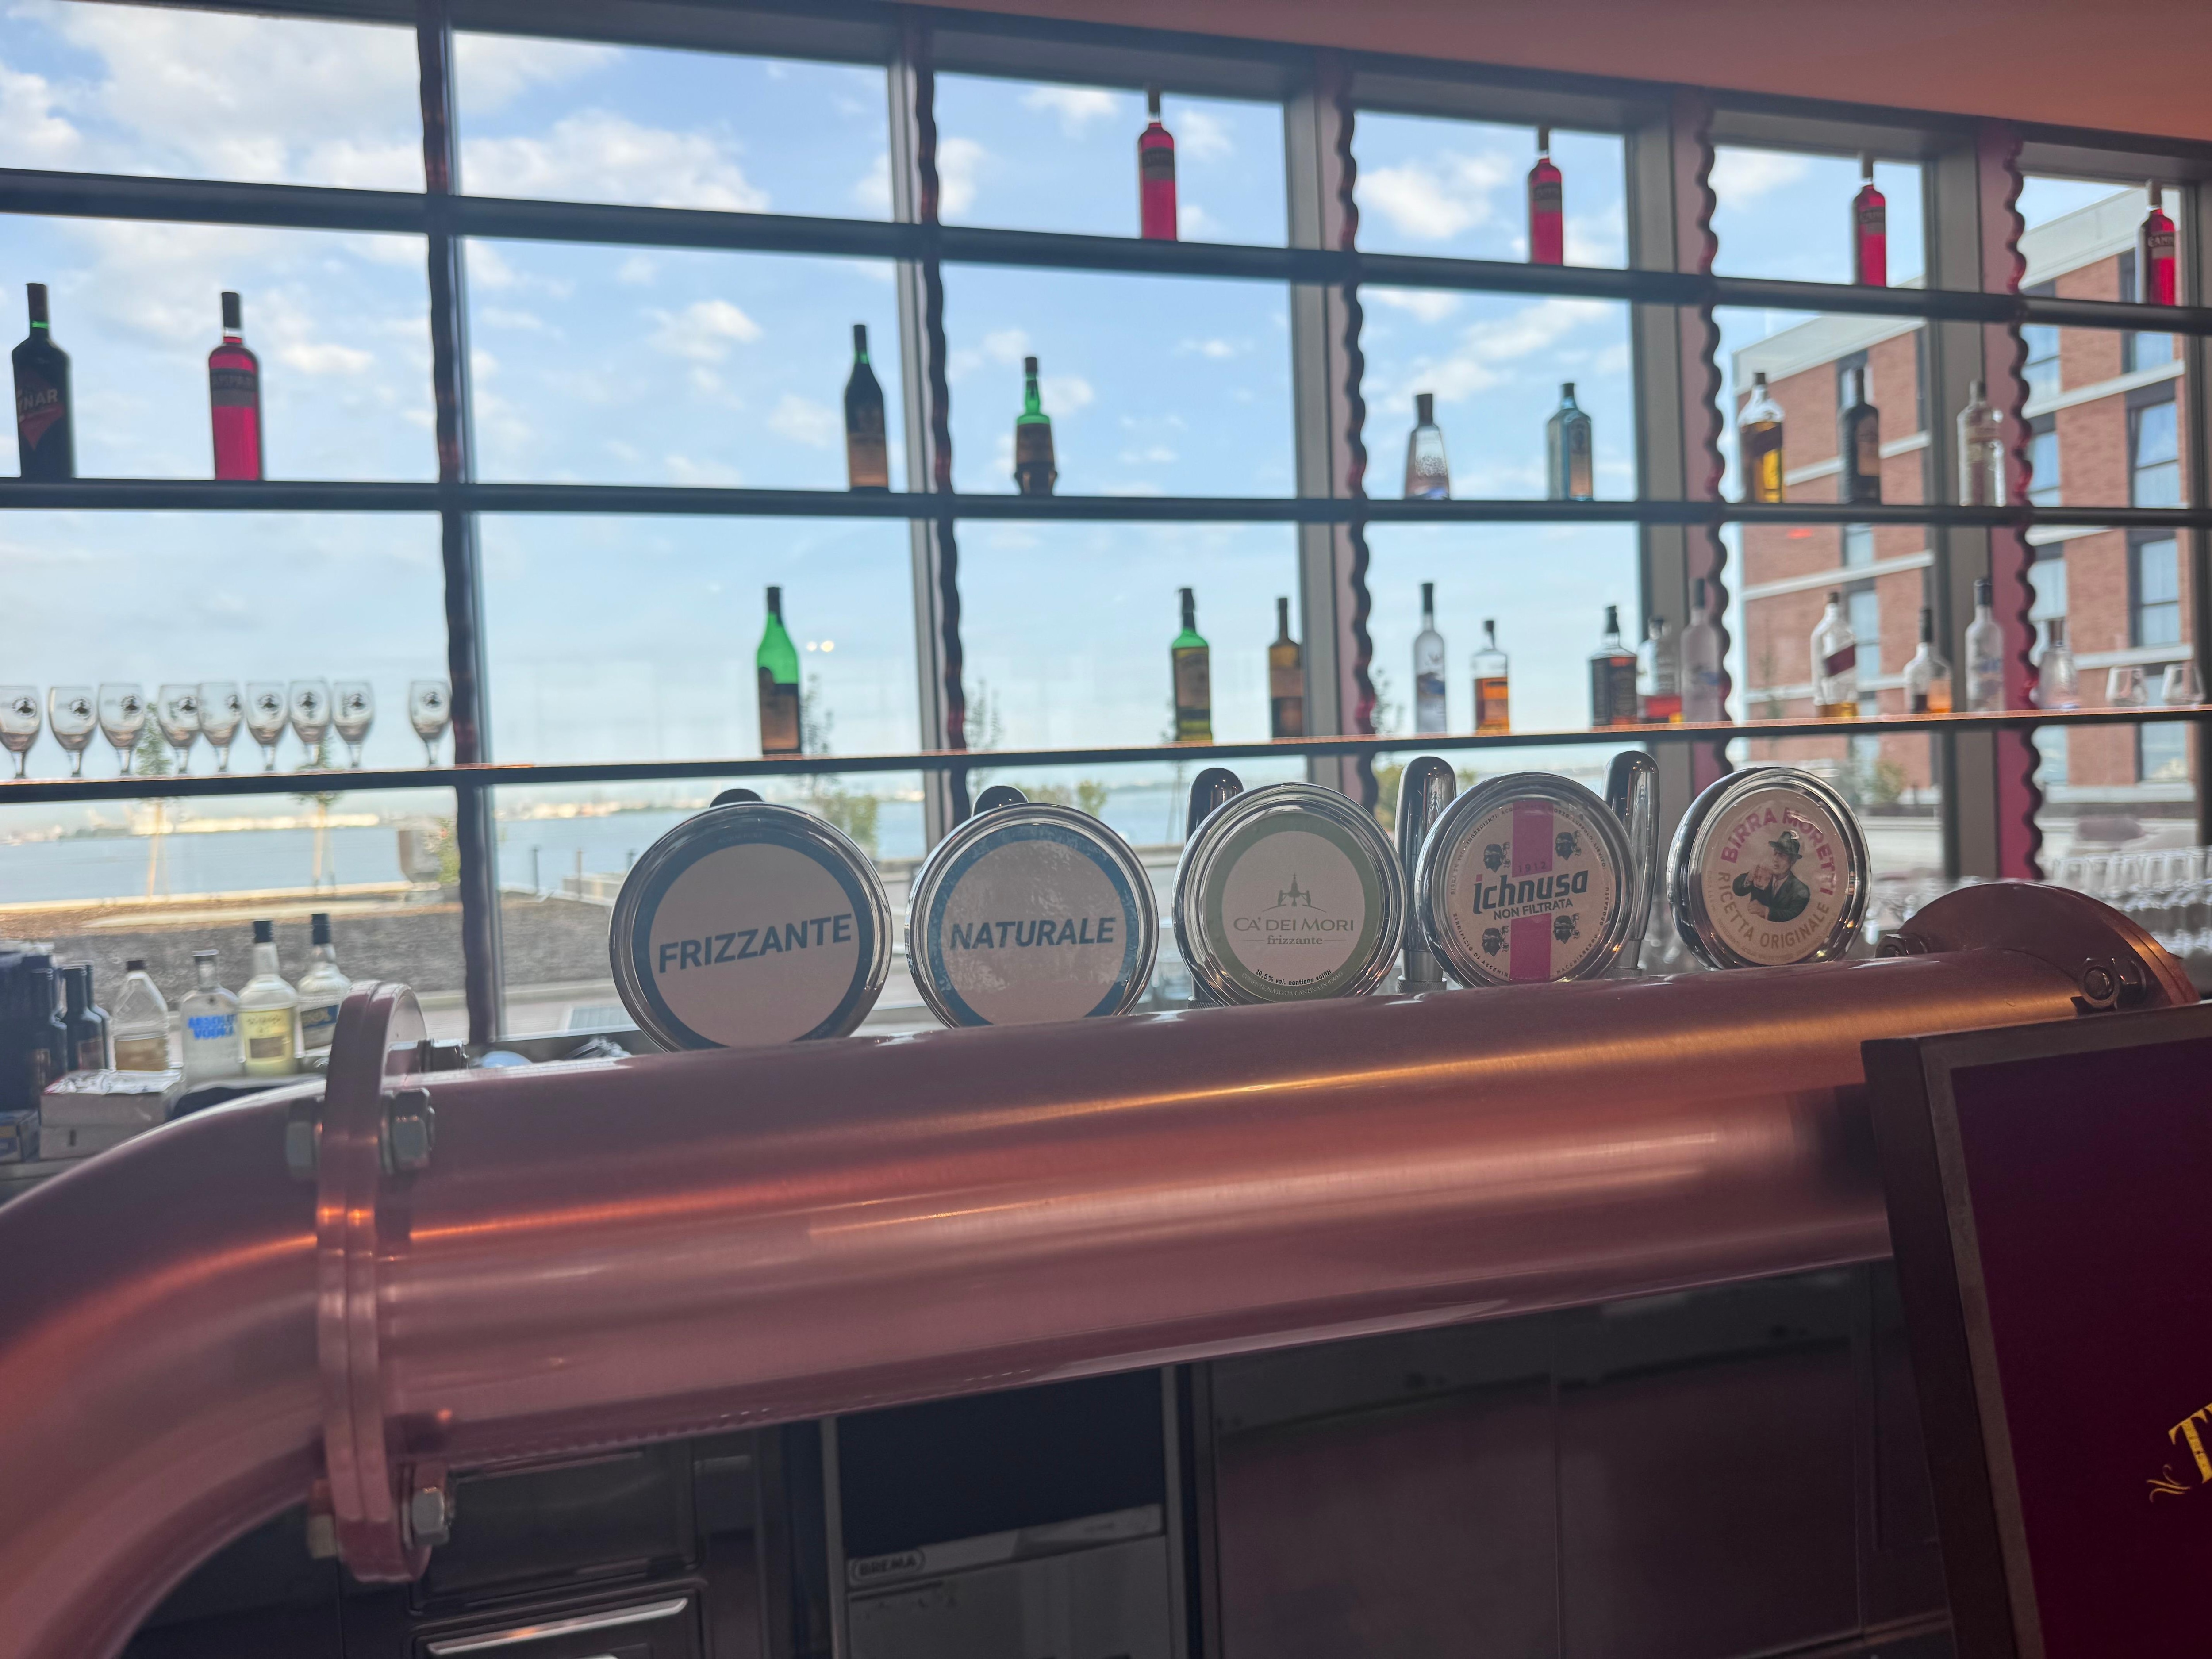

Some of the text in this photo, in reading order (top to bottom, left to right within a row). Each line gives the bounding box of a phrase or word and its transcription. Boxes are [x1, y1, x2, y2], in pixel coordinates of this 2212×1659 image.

[1518, 861, 1547, 873] 1912
[1721, 806, 1836, 895] BIRRA MORETTI
[1266, 919, 1296, 932] DEI
[1302, 918, 1354, 932] MORI
[1493, 898, 1573, 920] NON FILTRATA
[1718, 872, 1754, 941] RICETTA
[1759, 902, 1830, 949] ORIGINALE
[659, 913, 853, 974] FRIZZANTE
[950, 917, 1116, 951] NATURALE
[1267, 935, 1323, 945] frizzante
[2169, 1401, 2212, 1484] T
